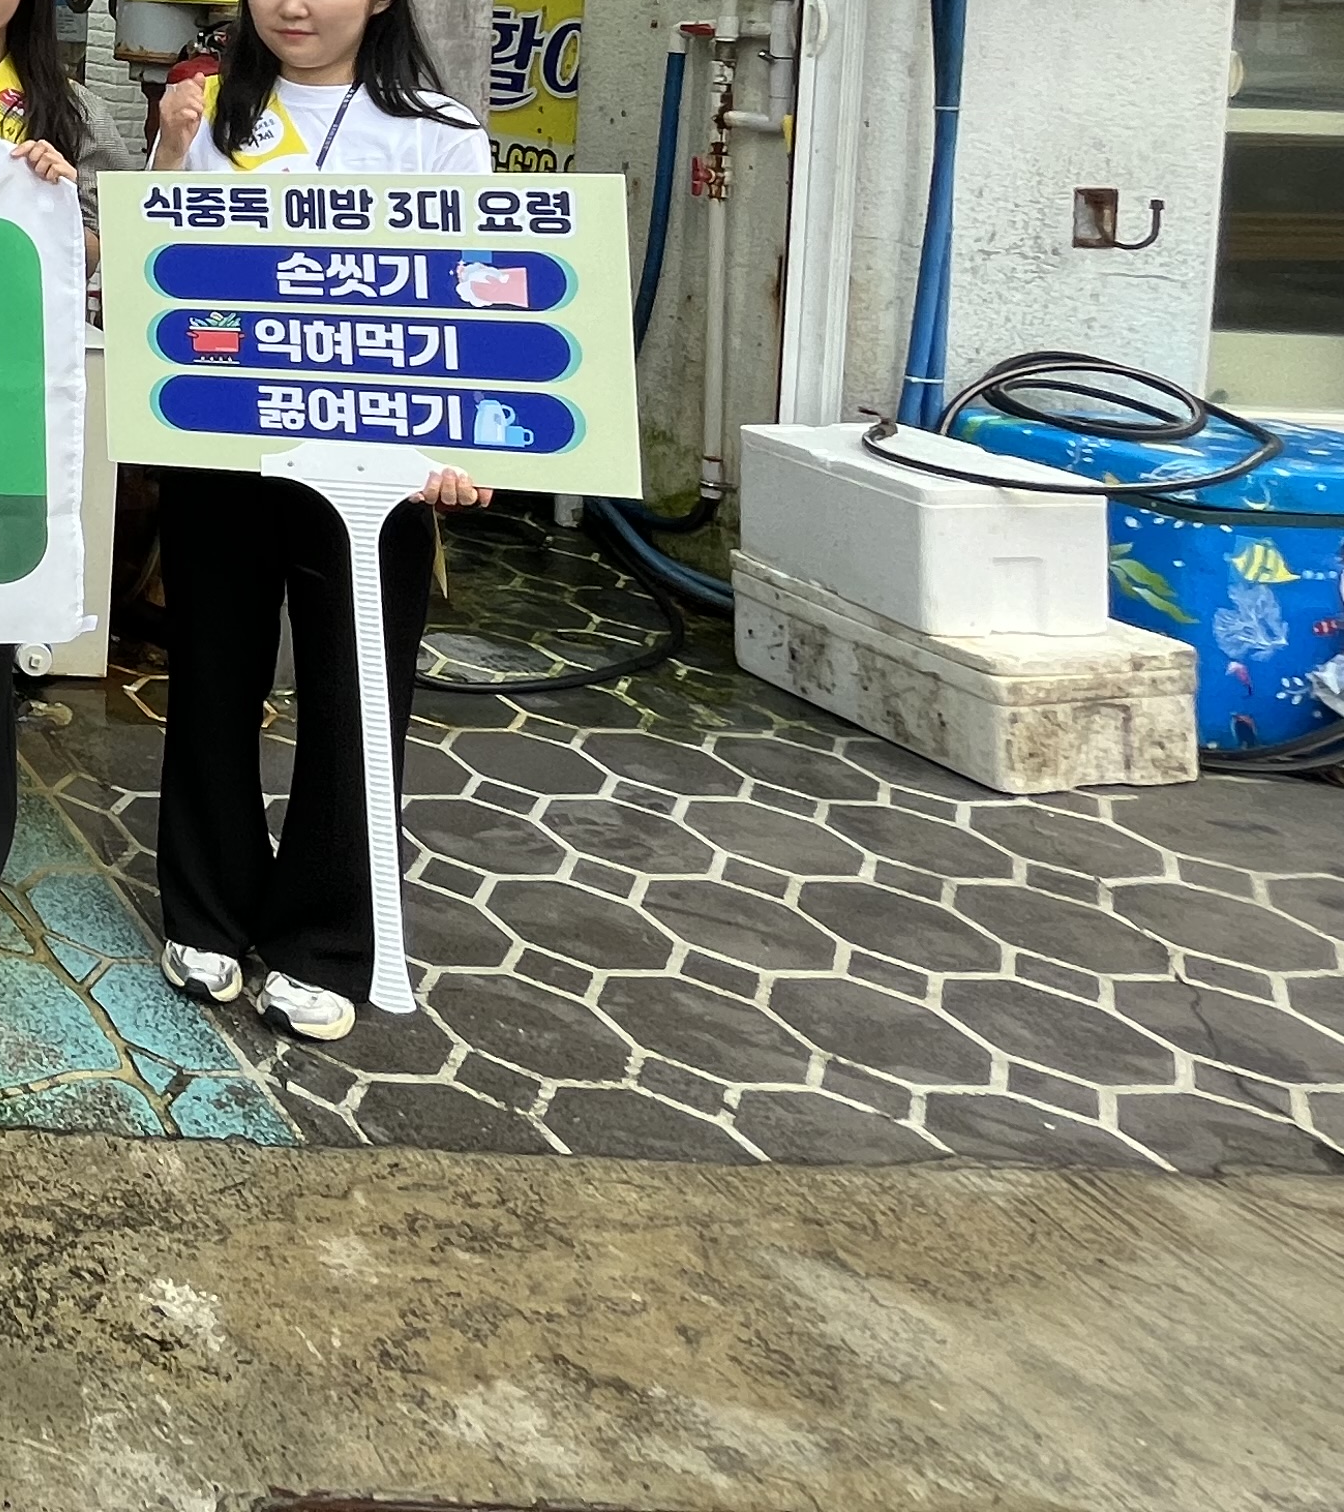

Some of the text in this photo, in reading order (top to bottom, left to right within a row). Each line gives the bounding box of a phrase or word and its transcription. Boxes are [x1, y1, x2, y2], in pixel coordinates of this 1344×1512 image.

[144, 186, 574, 235] 식중독 예방 3대 요령
[275, 251, 429, 300] 손씻기
[254, 319, 460, 372] 익혀먹기
[256, 385, 465, 441] 끓여먹기
